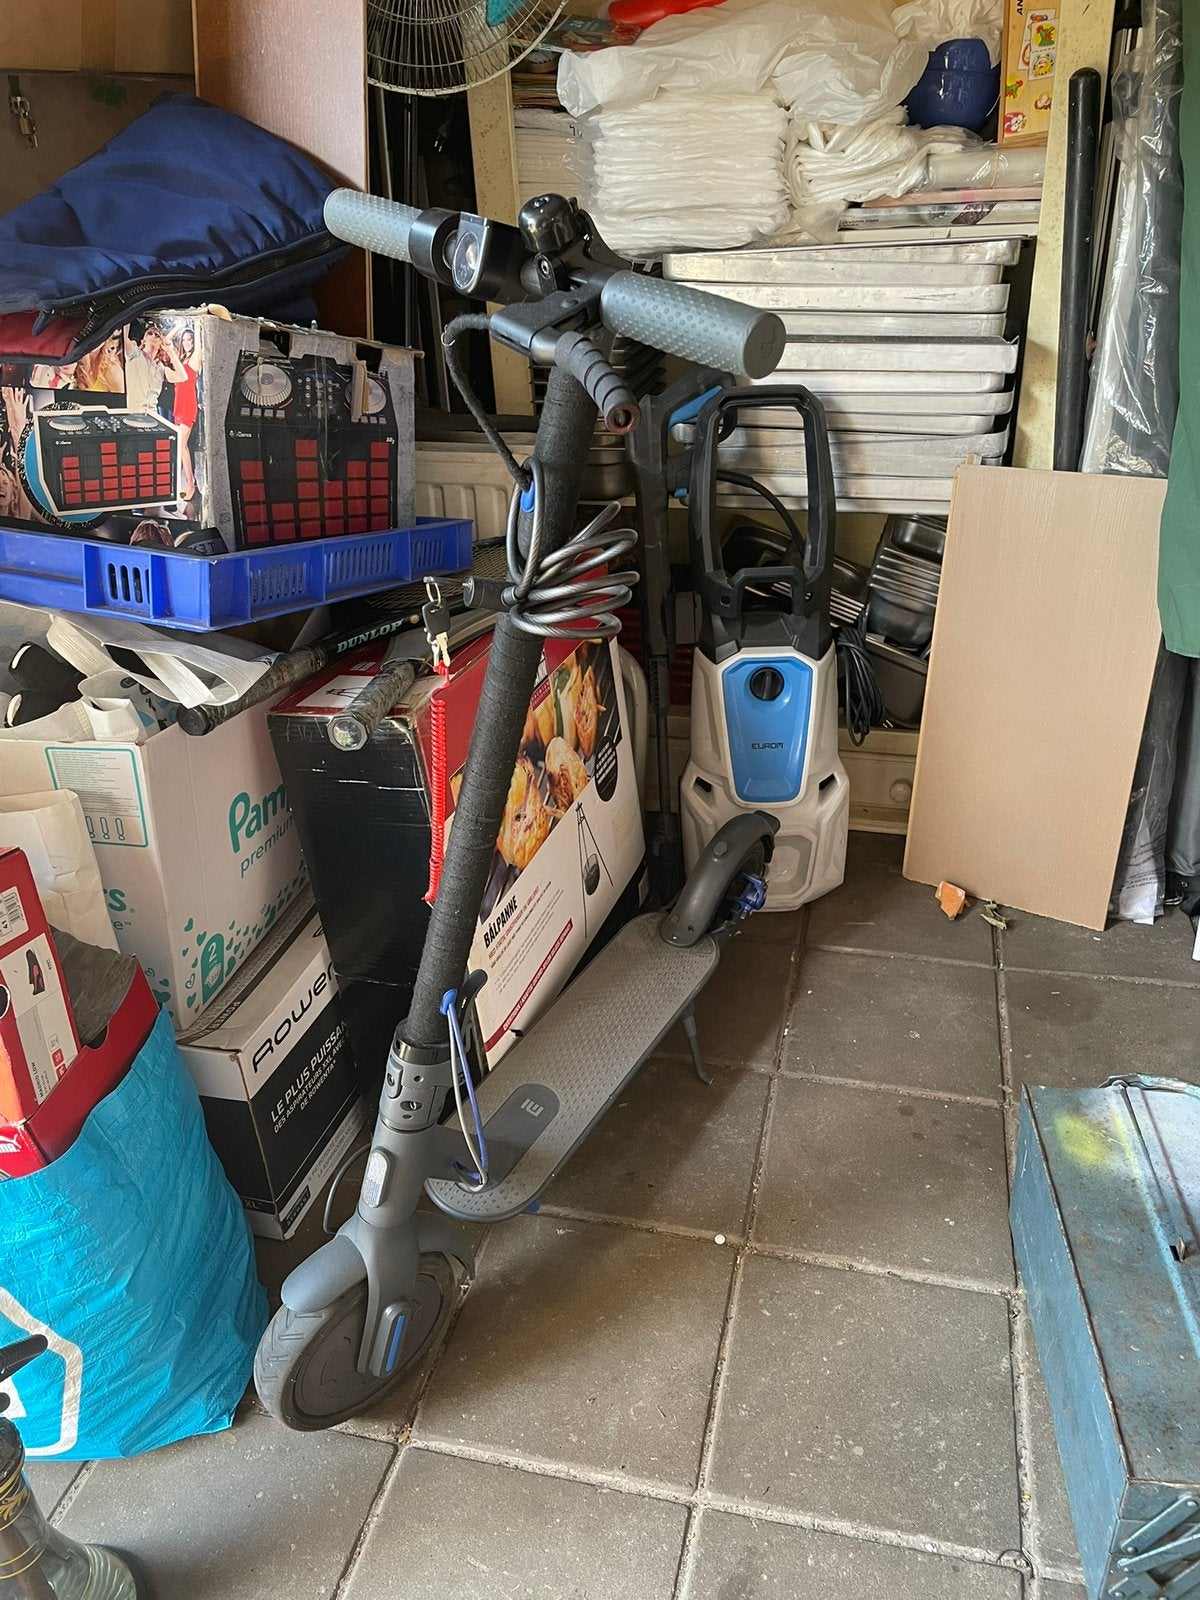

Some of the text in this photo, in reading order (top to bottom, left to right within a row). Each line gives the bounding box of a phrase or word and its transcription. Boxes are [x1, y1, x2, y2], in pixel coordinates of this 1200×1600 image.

[337, 619, 404, 653] DUNLOP
[752, 742, 784, 750] EUROM
[229, 784, 287, 853] Pam
[483, 895, 518, 949] BÅLPANNE
[208, 942, 216, 962] 2
[271, 1099, 285, 1122] LE
[285, 1066, 310, 1104] PLUS
[310, 1020, 347, 1071] PUISSAN
[274, 1115, 286, 1133] DES
[286, 1066, 322, 1118] ASPIRATEURS
[300, 1096, 309, 1110] DE
